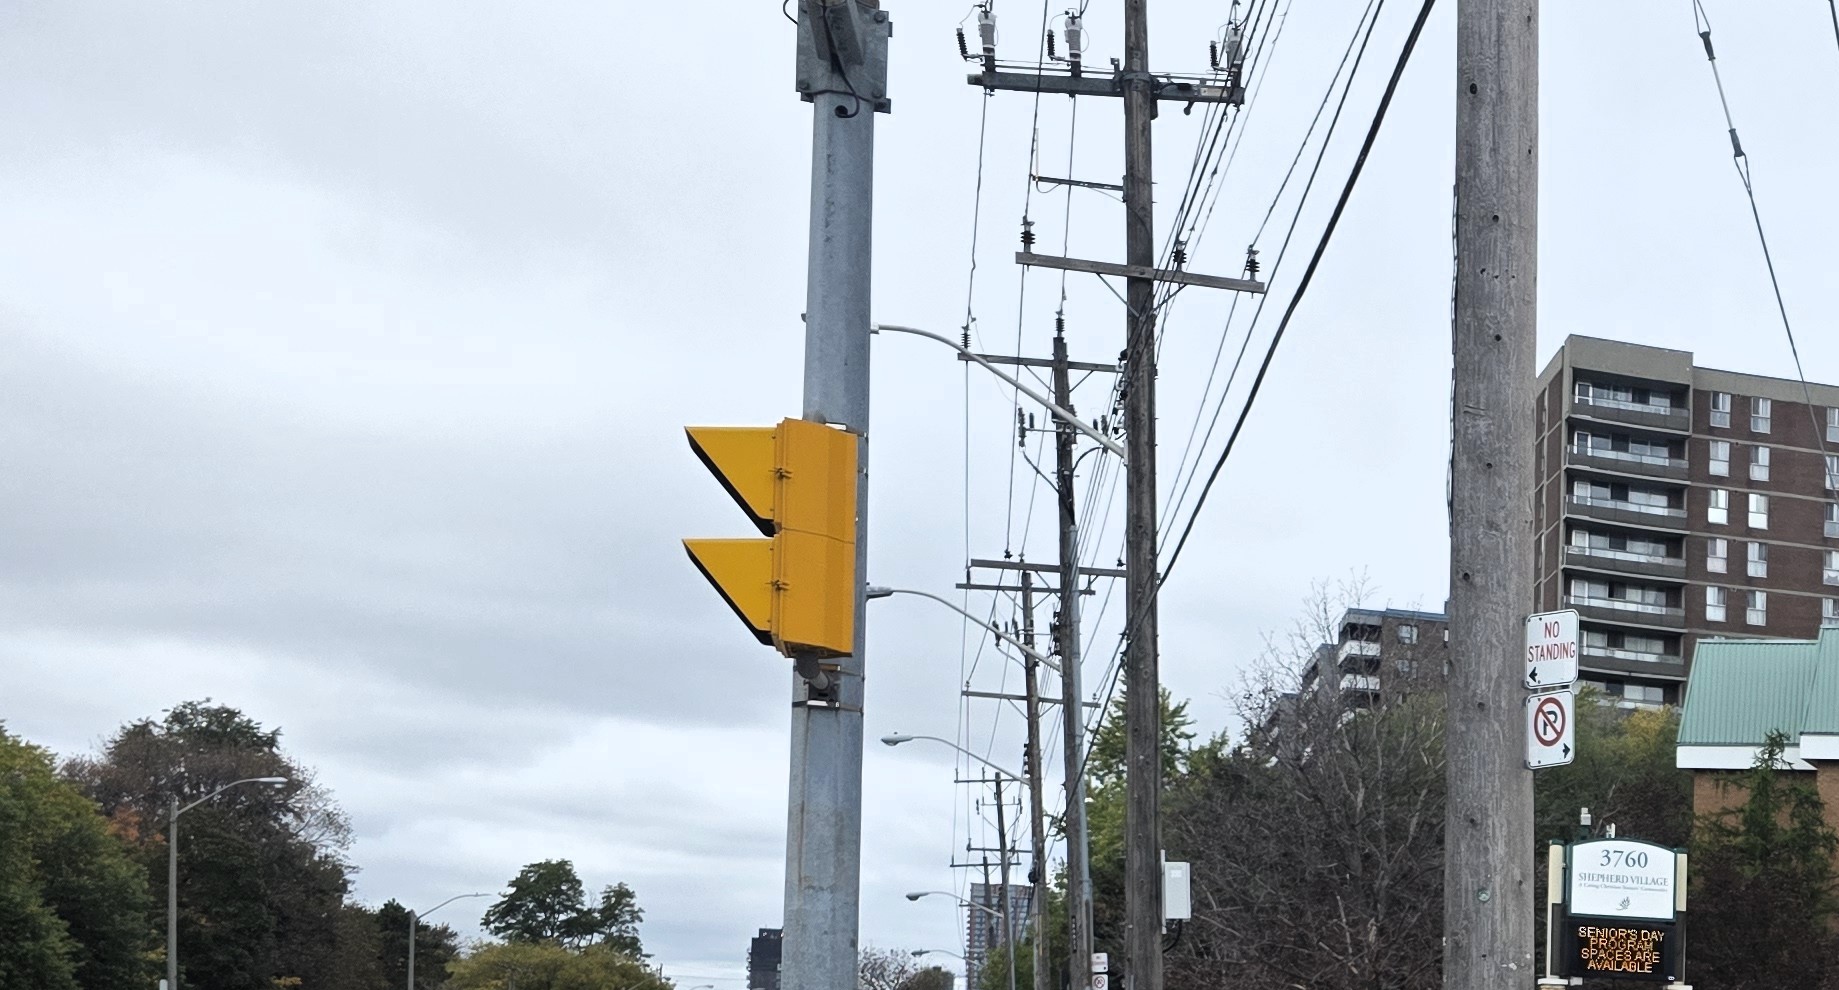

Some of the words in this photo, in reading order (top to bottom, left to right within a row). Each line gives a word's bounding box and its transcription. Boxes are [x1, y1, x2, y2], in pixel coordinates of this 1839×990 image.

[1544, 620, 1560, 639] NO
[1527, 641, 1576, 663] STANDING
[1600, 849, 1648, 869] 3760
[1578, 872, 1629, 884] SHEPHERD
[1630, 875, 1669, 887] VILLAGE
[1578, 926, 1638, 940] SENIOR'S
[1641, 929, 1665, 942] DAY
[1589, 938, 1654, 951] PROGRAM
[1581, 948, 1632, 961] SPACES
[1634, 950, 1661, 963] ARE
[1587, 960, 1653, 973] AVAILABLE
